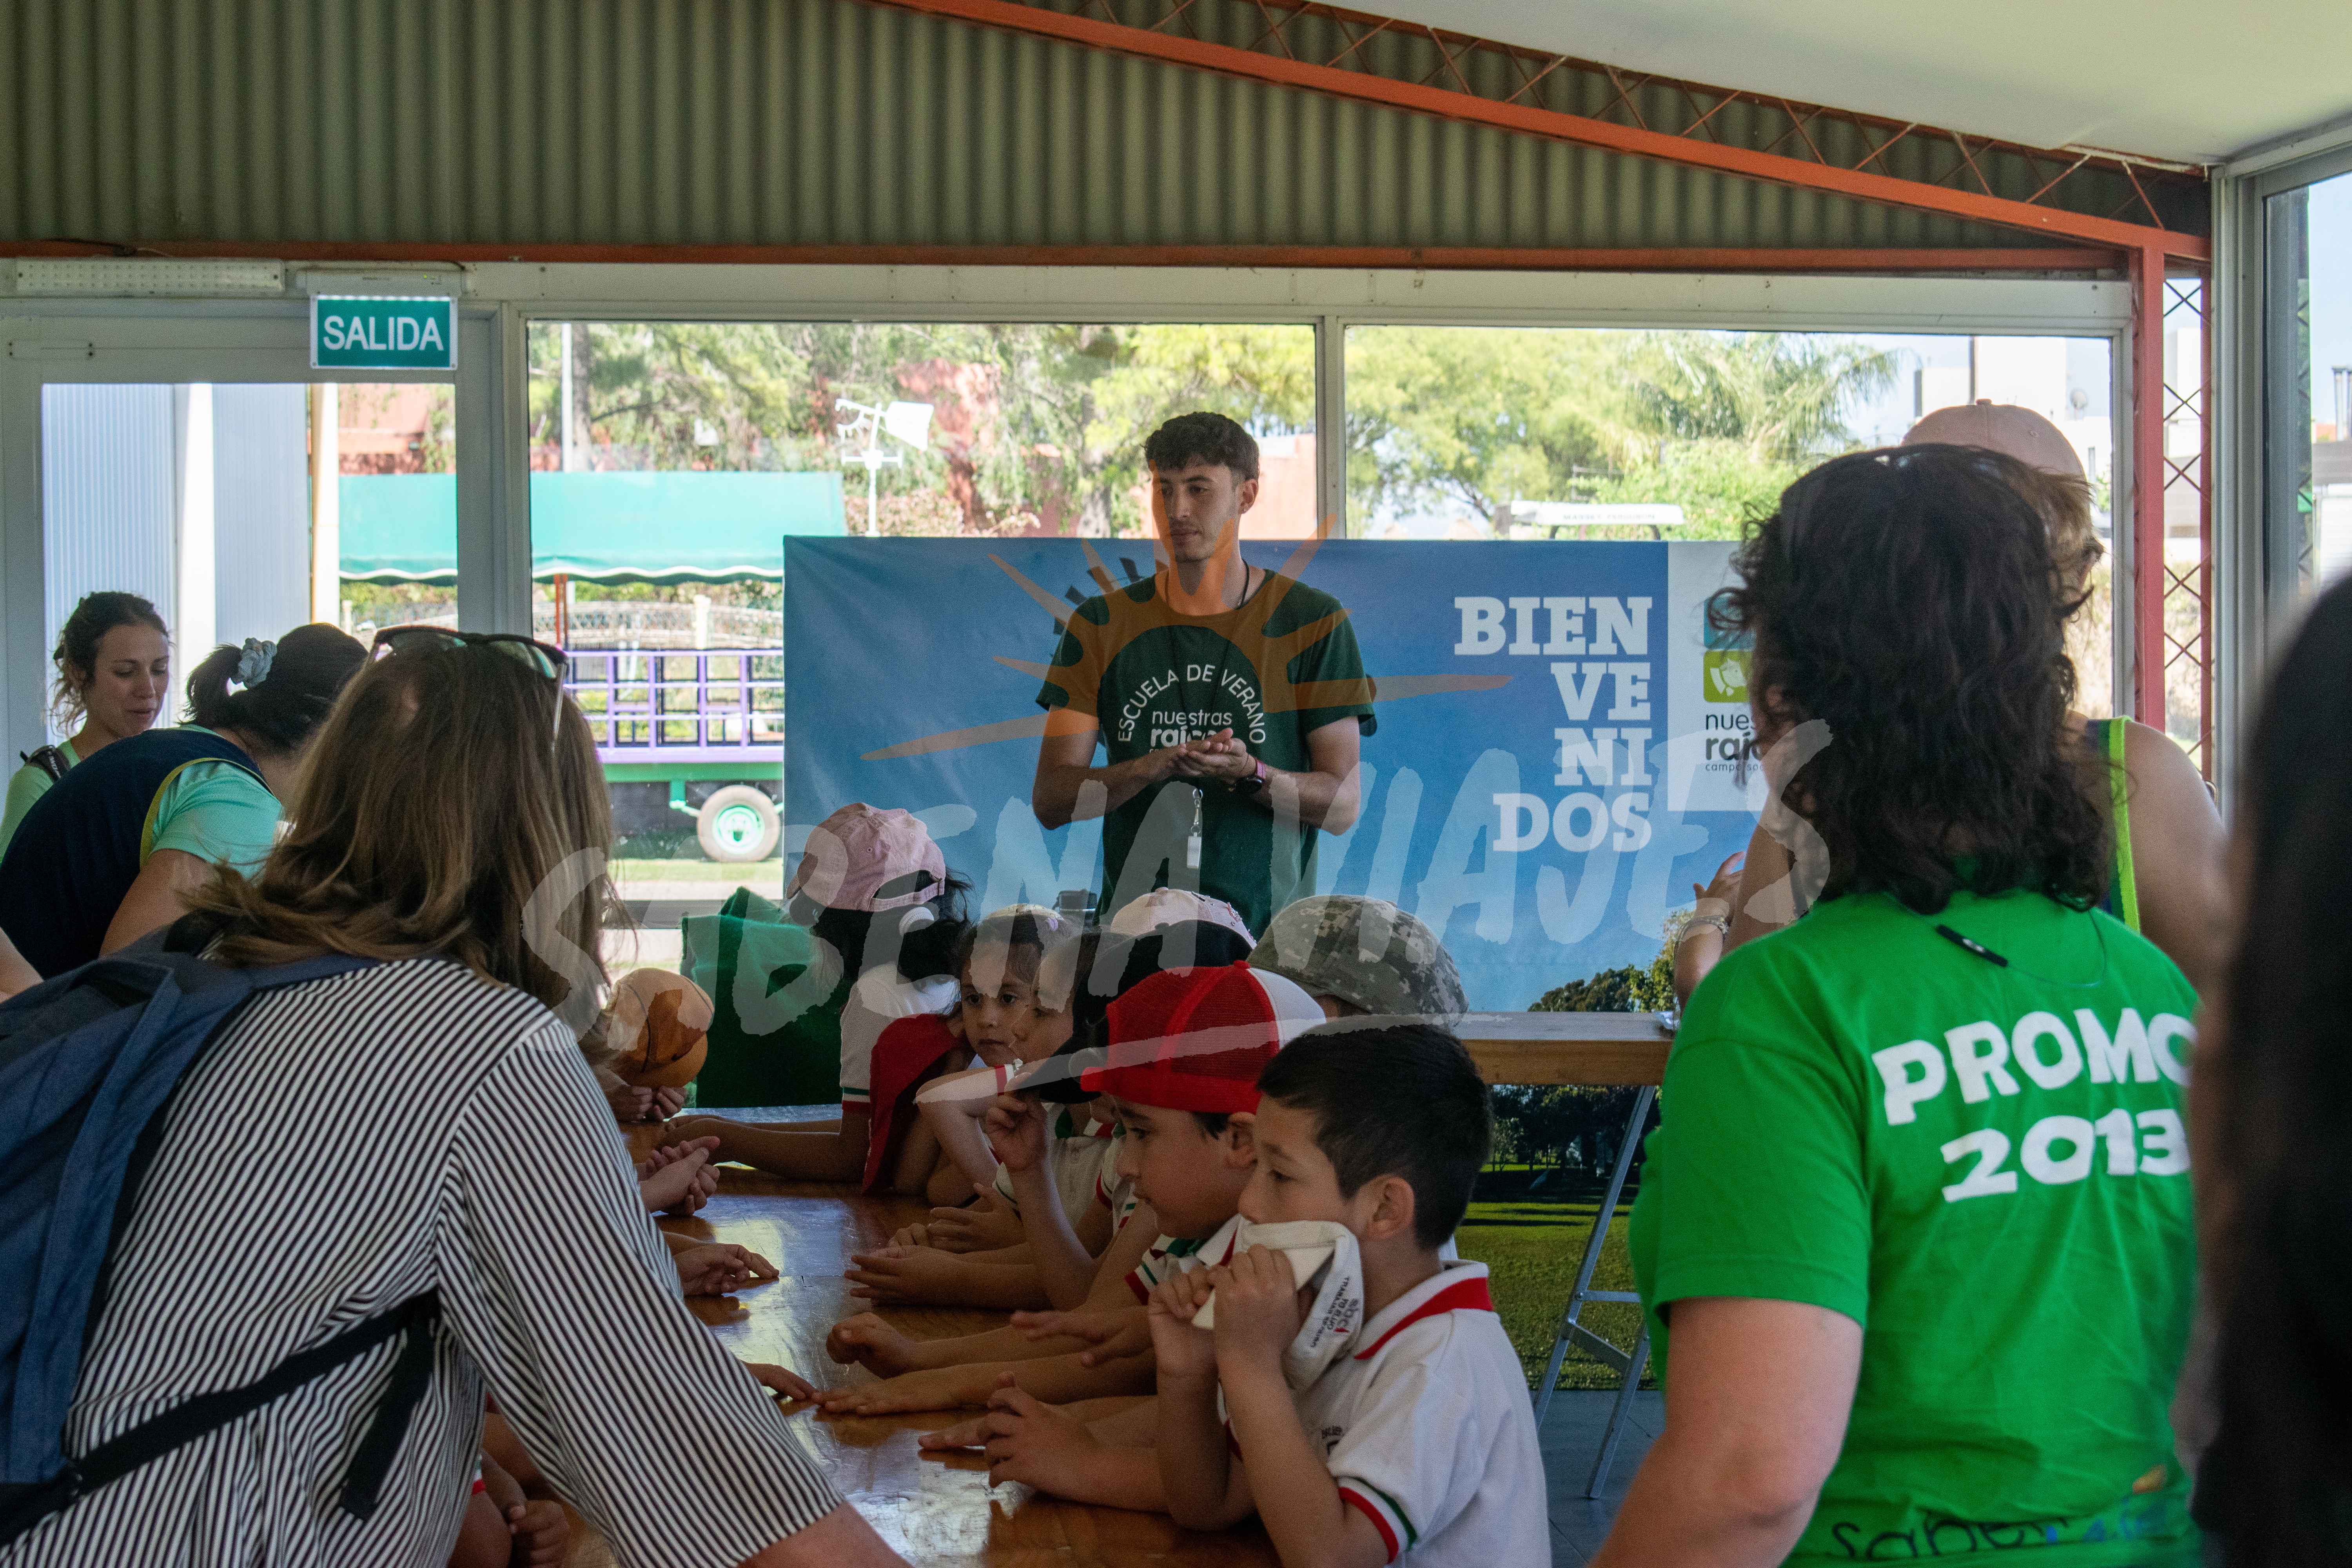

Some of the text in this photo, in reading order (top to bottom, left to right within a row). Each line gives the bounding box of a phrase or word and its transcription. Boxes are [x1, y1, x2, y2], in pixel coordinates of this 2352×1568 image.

[323, 315, 444, 350] SALIDA
[1454, 596, 1652, 656] BIEN
[1118, 664, 1266, 744] ESCUELA DE VERANO
[1152, 709, 1232, 726] nuestras
[1551, 662, 1651, 721] VE
[1706, 713, 1754, 730] nue
[1554, 727, 1652, 786] NI
[1492, 792, 1652, 853] DOS
[1871, 1007, 2198, 1125] PROMO
[1940, 1108, 2190, 1203] 2013
